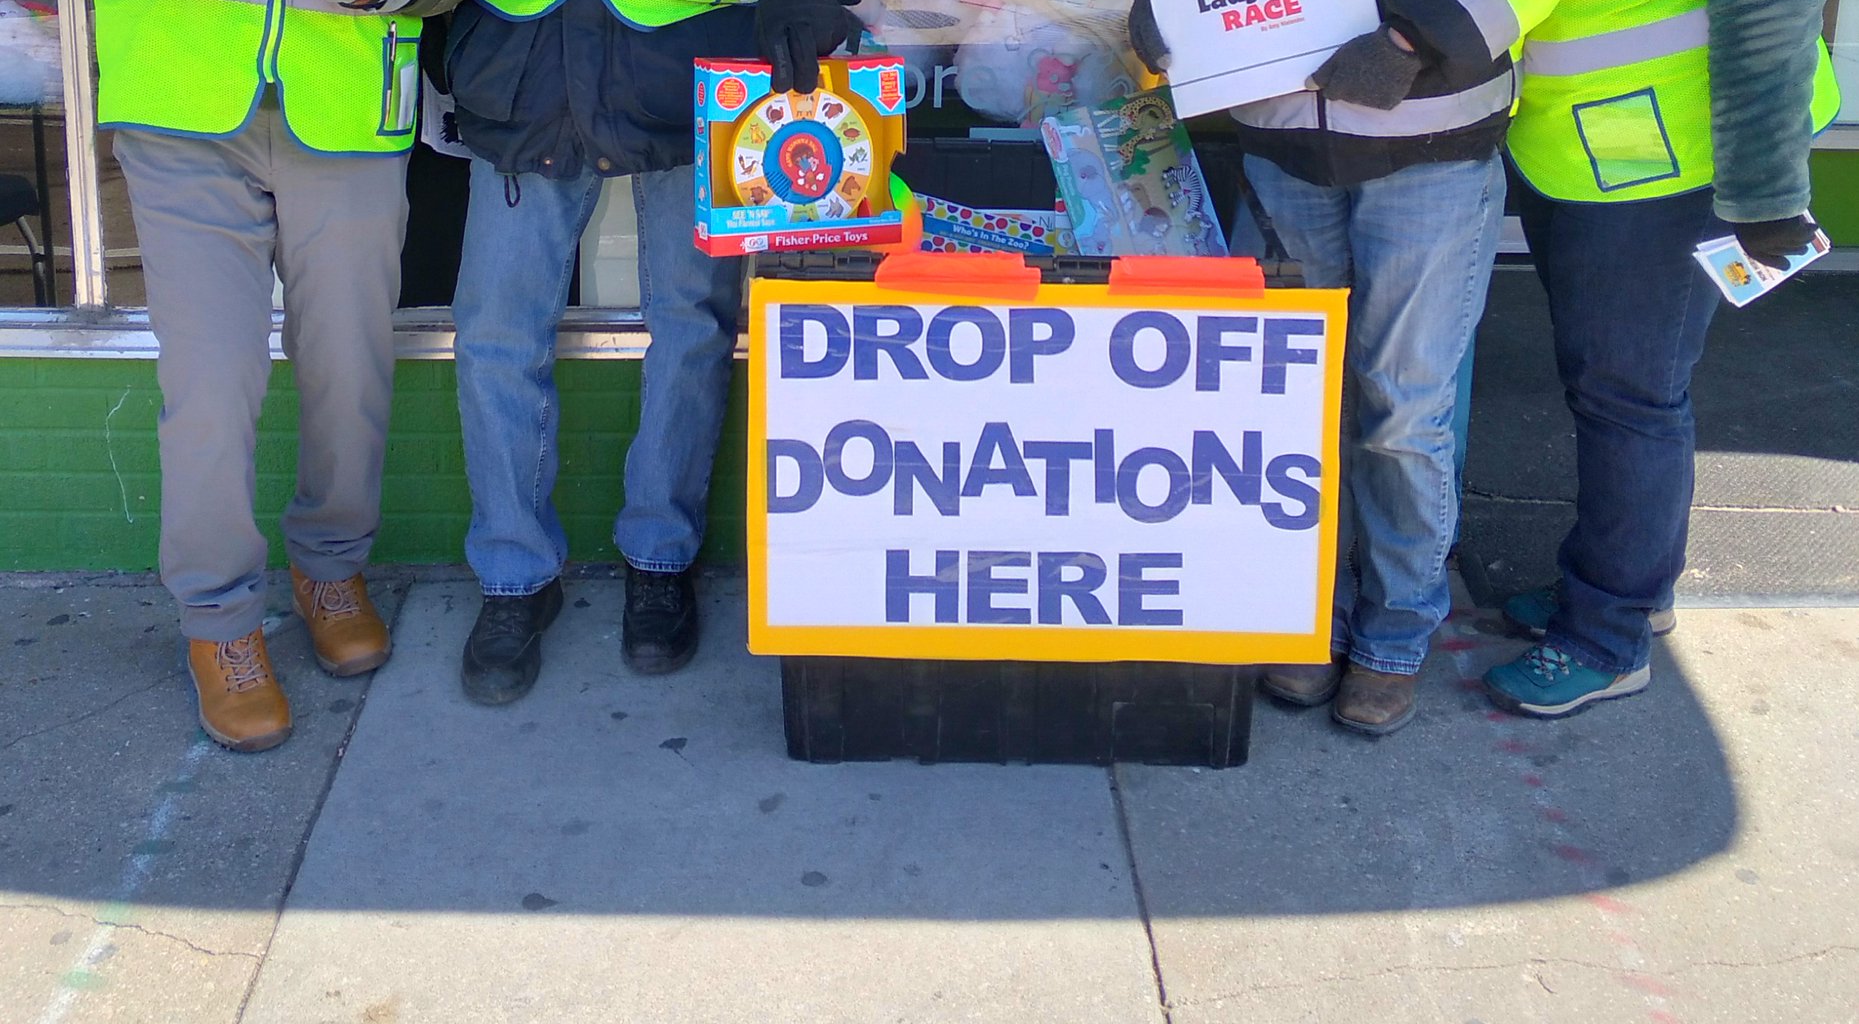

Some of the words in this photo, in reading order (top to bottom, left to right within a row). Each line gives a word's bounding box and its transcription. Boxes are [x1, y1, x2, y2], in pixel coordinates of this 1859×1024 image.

[775, 233, 841, 247] Fisher-Price
[844, 231, 869, 243] Toys
[952, 224, 979, 238] Who's
[980, 231, 989, 240] In
[990, 232, 1007, 245] The
[1007, 237, 1030, 251] Zoo?
[780, 304, 1075, 384] DROP
[1109, 310, 1324, 394] OFF
[764, 419, 1326, 530] DONATIONS
[885, 549, 1183, 626] HERE
